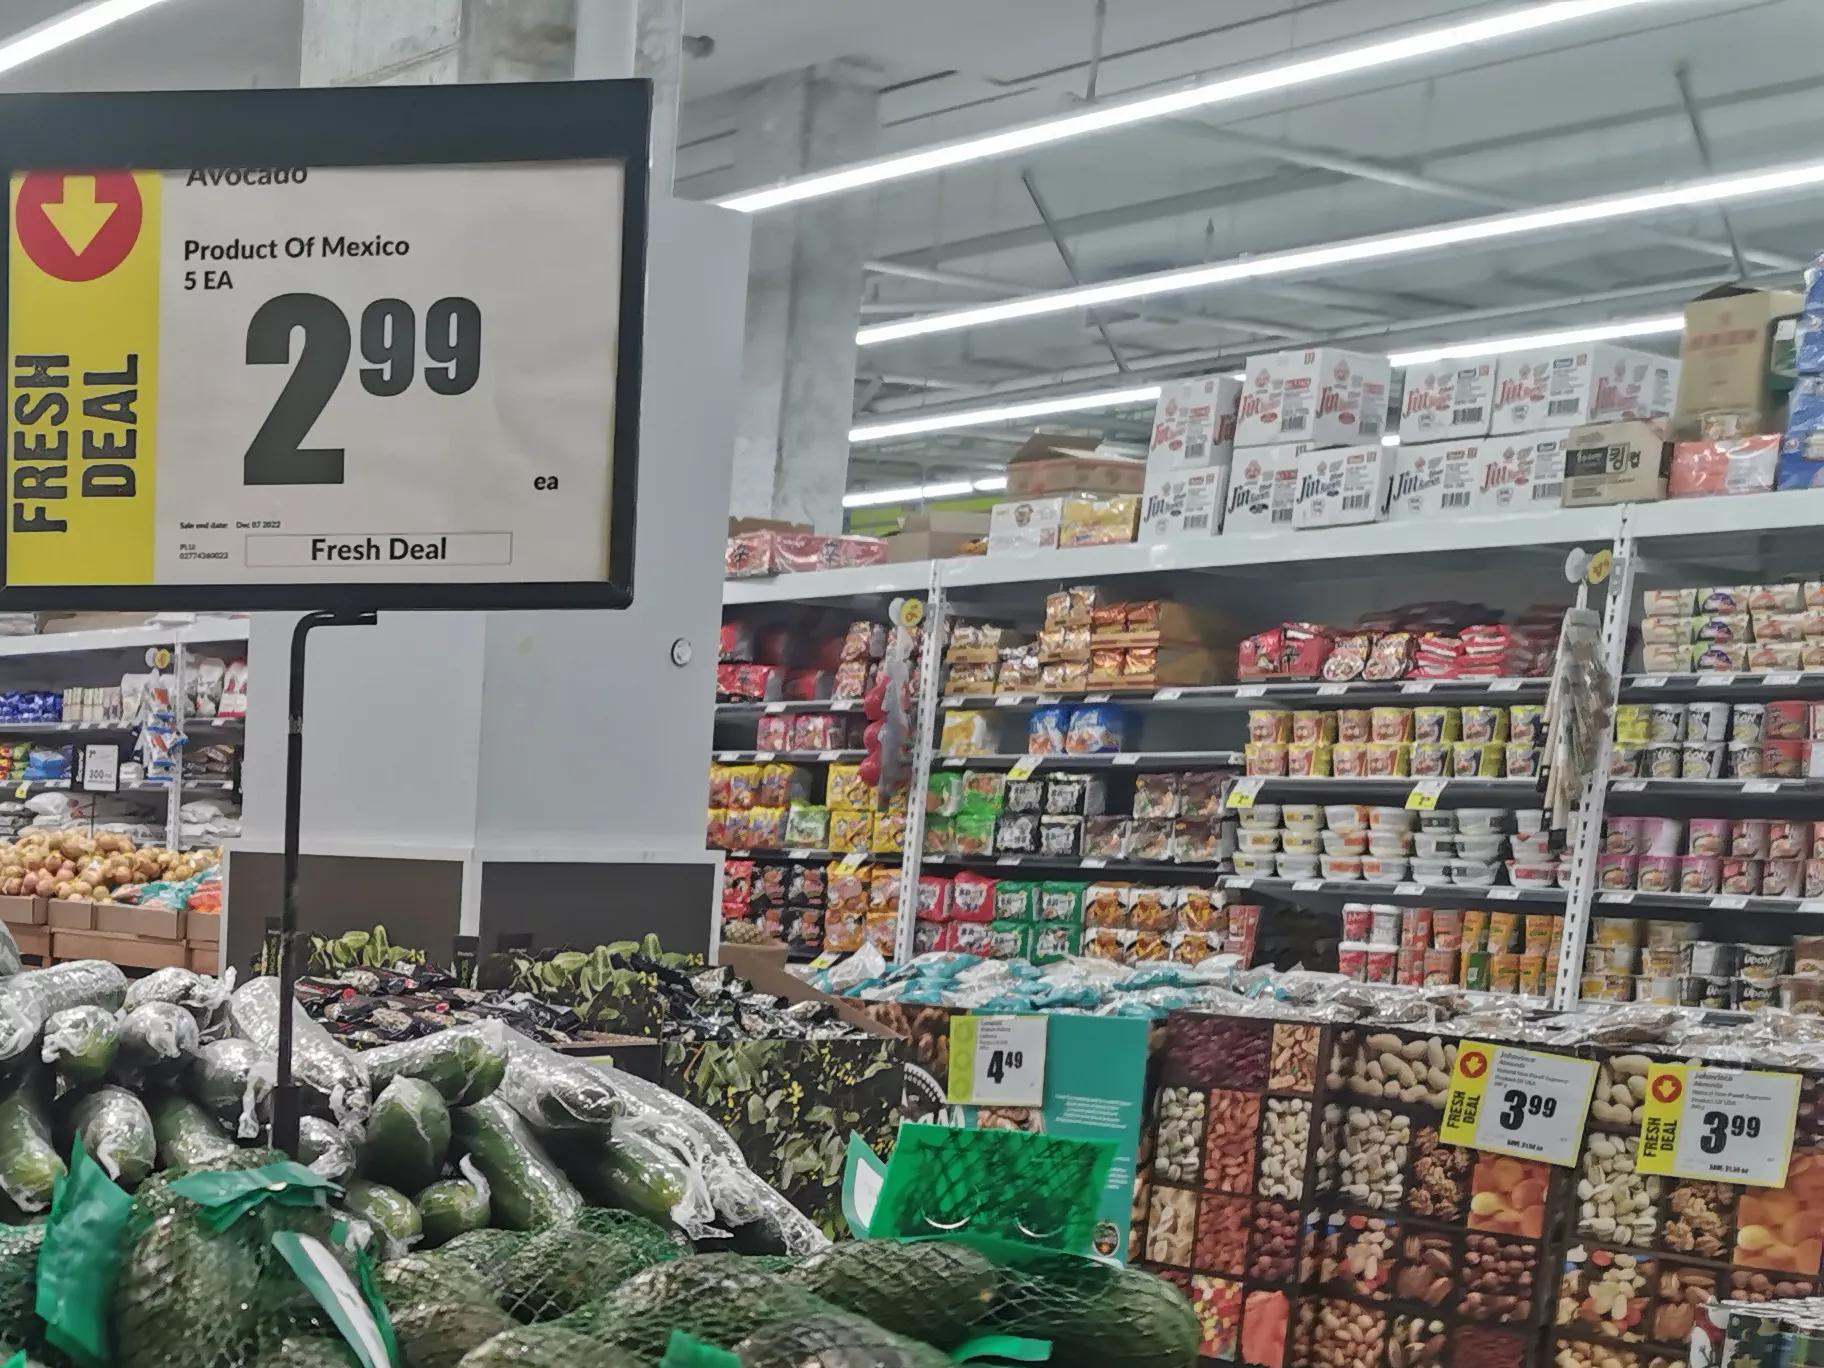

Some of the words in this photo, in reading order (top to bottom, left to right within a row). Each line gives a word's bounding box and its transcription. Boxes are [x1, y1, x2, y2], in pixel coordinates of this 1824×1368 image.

[184, 238, 278, 261] Product
[284, 237, 315, 259] Of
[321, 234, 410, 258] Mexico
[183, 271, 197, 290] 5
[204, 270, 234, 290] EA
[81, 353, 138, 497] DEAL
[13, 355, 70, 533] FRESH
[532, 473, 559, 491] ea
[1296, 474, 1321, 504] Jin
[1228, 484, 1250, 514] Jin
[311, 537, 381, 561] Fresh
[388, 536, 447, 561] Deal
[1447, 1090, 1466, 1129] FRESH
[1462, 1094, 1480, 1124] DEAL
[1643, 1117, 1662, 1158] FRESH
[1660, 1120, 1678, 1152] DEAL
